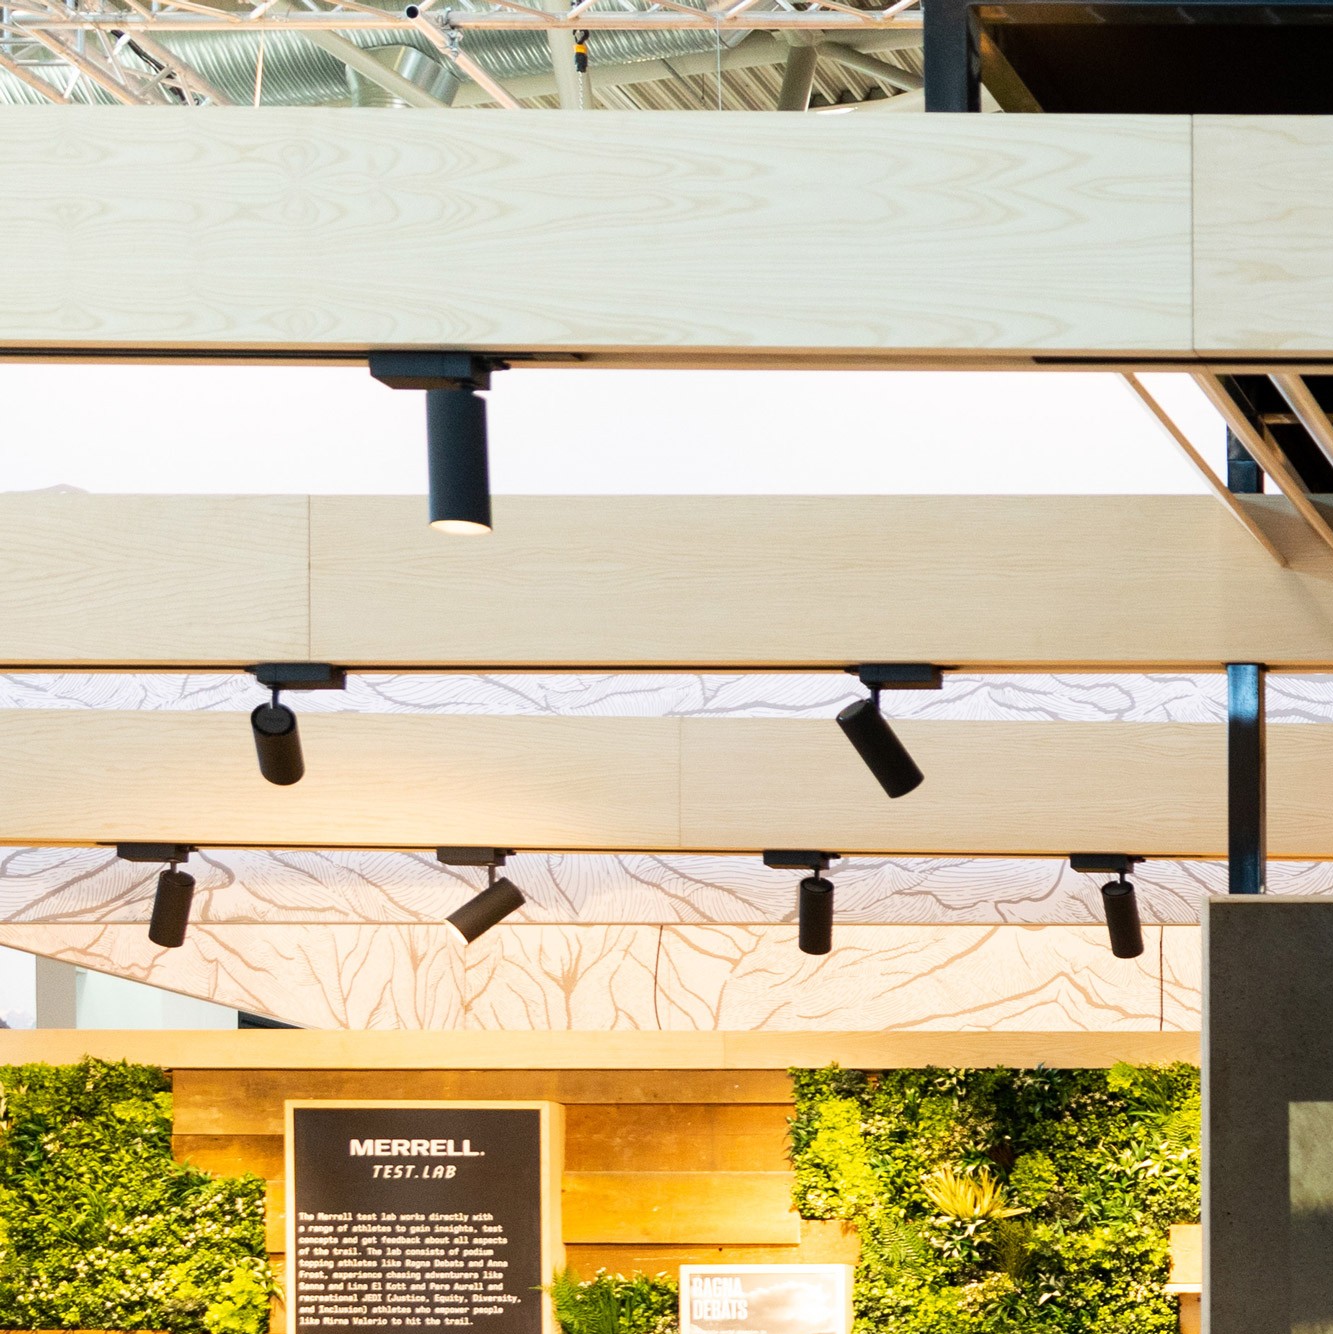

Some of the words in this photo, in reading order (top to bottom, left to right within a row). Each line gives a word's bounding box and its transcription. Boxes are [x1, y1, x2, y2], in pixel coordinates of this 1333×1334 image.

[372, 1165, 457, 1178] TEST.LAB
[298, 1212, 313, 1221] The
[317, 1212, 352, 1221] Merrell
[356, 1212, 377, 1221] test
[381, 1212, 396, 1221] lab
[400, 1212, 425, 1221] works
[430, 1212, 469, 1223] directly
[474, 1212, 494, 1221] with
[298, 1225, 303, 1233] a
[308, 1225, 333, 1235] range
[337, 1224, 347, 1233] of
[352, 1224, 391, 1233] athletes
[396, 1224, 406, 1233] to
[410, 1224, 431, 1235] gain
[484, 1224, 504, 1233] test
[298, 1236, 338, 1247] concepts
[342, 1236, 357, 1245] and
[361, 1236, 377, 1247] get
[381, 1236, 421, 1245] feedback
[425, 1236, 450, 1245] about
[454, 1236, 470, 1245] all
[474, 1236, 509, 1247] aspects
[298, 1247, 309, 1256] of
[313, 1247, 328, 1256] the
[367, 1247, 382, 1256] The
[386, 1247, 402, 1256] lab
[406, 1247, 446, 1256] consists
[450, 1247, 460, 1256] of
[465, 1247, 495, 1258] podium
[298, 1259, 333, 1270] topping
[337, 1259, 377, 1268] athletes
[381, 1259, 401, 1268] like
[406, 1259, 431, 1270] Ragna
[435, 1259, 465, 1268] Debats
[469, 1259, 484, 1268] and
[489, 1259, 509, 1268] Anna
[332, 1270, 382, 1281] experience
[386, 1270, 421, 1281] chasing
[425, 1270, 479, 1279] adventurers
[484, 1270, 504, 1279] like
[328, 1282, 343, 1291] and
[371, 1282, 382, 1291] El
[386, 1282, 406, 1291] Kott
[410, 1282, 426, 1291] and
[454, 1282, 484, 1291] Aurell
[488, 1282, 504, 1291] and
[692, 1277, 743, 1297] RAGNA
[298, 1294, 357, 1303] recreational
[361, 1294, 381, 1303] JEDI
[298, 1305, 314, 1314] and
[372, 1305, 412, 1314] athletes
[416, 1305, 431, 1314] who
[475, 1305, 505, 1316] people
[693, 1300, 748, 1319] DEBATS
[299, 1317, 319, 1326] like
[352, 1317, 387, 1326] Valerio
[391, 1317, 401, 1326] to
[405, 1317, 420, 1326] hit
[425, 1317, 440, 1326] the
